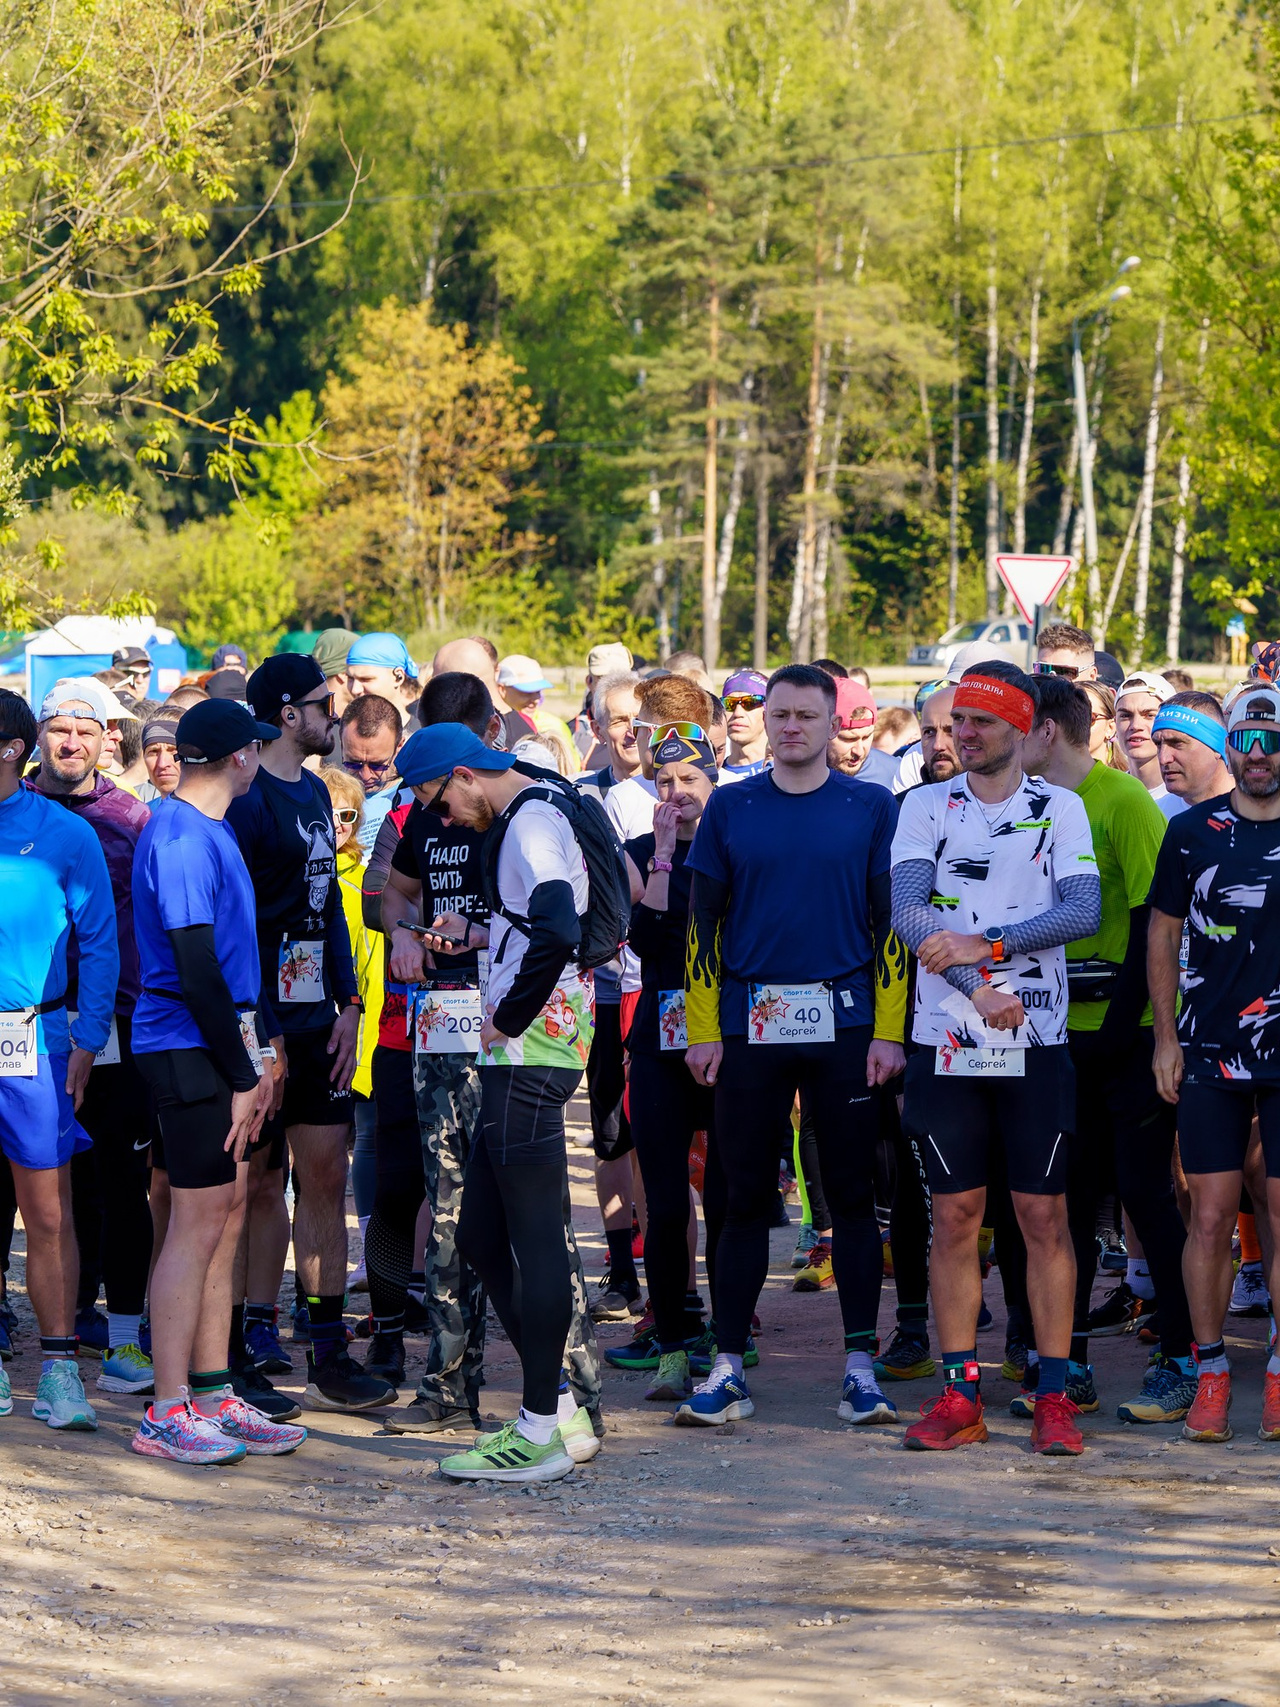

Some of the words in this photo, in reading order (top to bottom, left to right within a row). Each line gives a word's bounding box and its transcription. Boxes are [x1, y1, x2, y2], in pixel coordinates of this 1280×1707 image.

[970, 681, 983, 689] FOX
[983, 683, 1004, 696] ULTRA
[429, 844, 470, 865] НАДО
[429, 870, 463, 891] БИТЬ
[794, 1007, 821, 1024] 40
[447, 1016, 483, 1034] 203
[779, 1026, 816, 1037] Сергей
[968, 1059, 1006, 1070] Сергей
